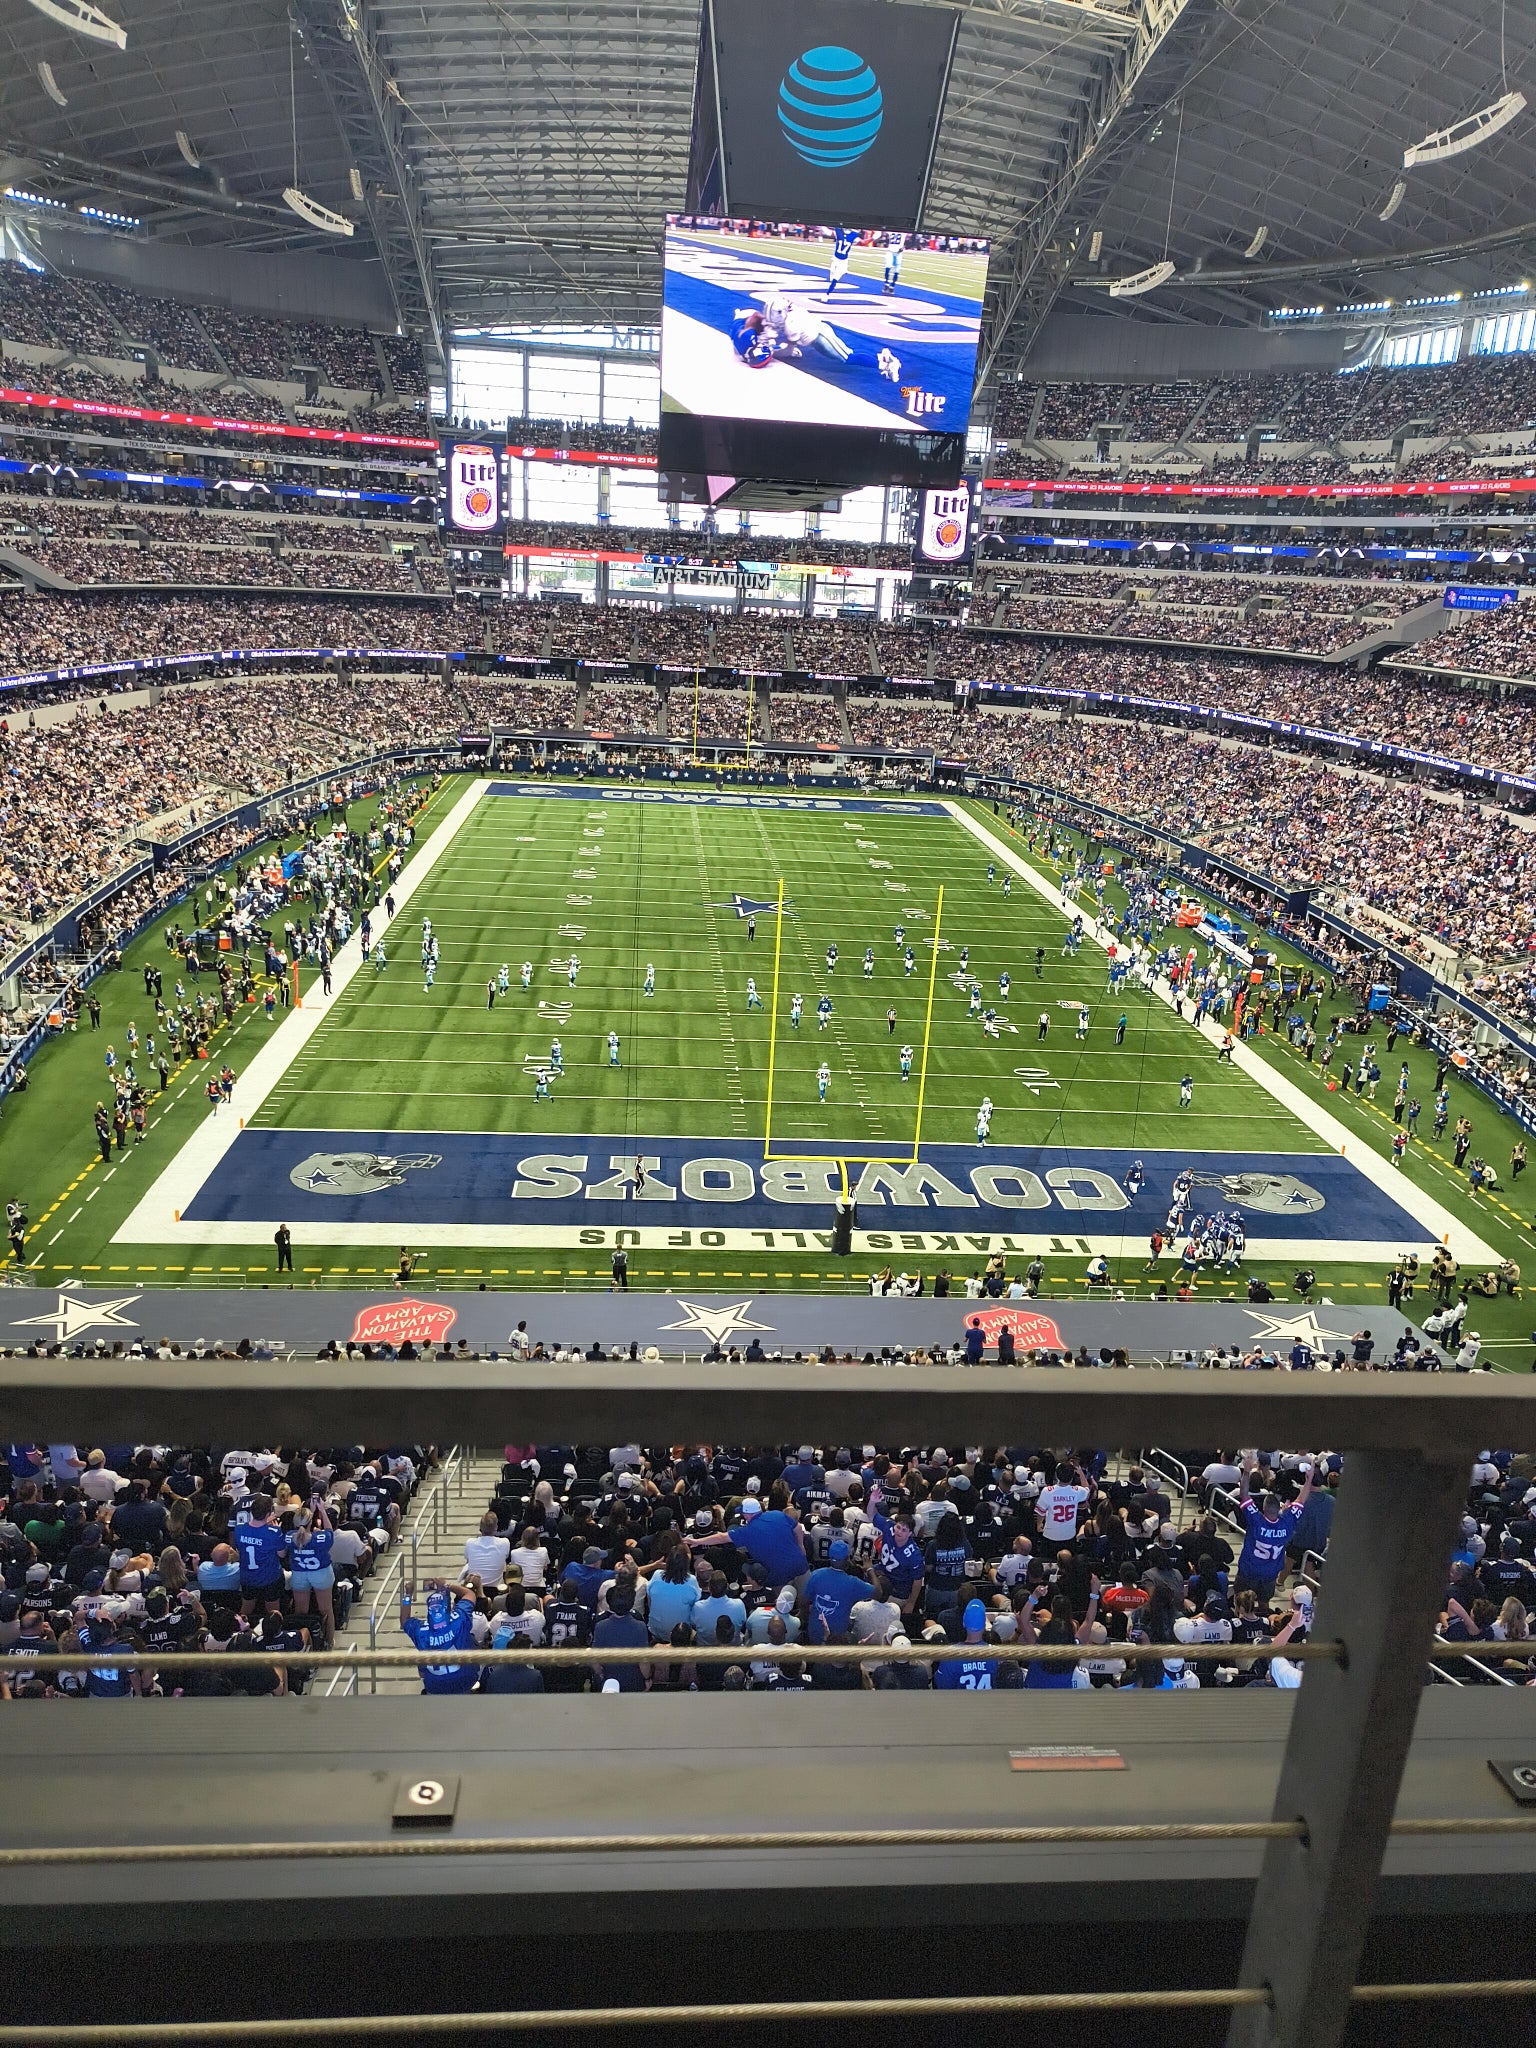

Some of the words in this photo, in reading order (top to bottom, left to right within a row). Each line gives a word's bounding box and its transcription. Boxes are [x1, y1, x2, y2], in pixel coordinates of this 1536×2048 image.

[836, 239, 852, 254] 17
[906, 391, 946, 417] Lite
[461, 463, 495, 485] Lite
[933, 495, 967, 517] Lite
[654, 568, 694, 584] AT&T
[698, 571, 769, 590] STADIUM
[506, 656, 550, 664] Blockchain.com
[601, 790, 842, 808] COWBOYS
[537, 1000, 573, 1019] 20
[522, 1054, 563, 1075] 10
[1014, 1067, 1062, 1089] 10
[511, 1154, 1128, 1211] COWBOYS
[579, 1230, 641, 1245] US
[668, 1230, 726, 1246] OF
[752, 1232, 851, 1248] ALL
[866, 1234, 1024, 1252] TAKES
[1050, 1238, 1092, 1253] IT
[369, 1305, 424, 1325] ARMY
[980, 1313, 1018, 1330] ARMY
[361, 1311, 451, 1338] SALVATION
[394, 1326, 432, 1340] THE
[1016, 1333, 1048, 1347] THE
[228, 1456, 248, 1465] BRYANT
[806, 1490, 830, 1498] AIKMAN
[351, 1503, 380, 1518] 87
[1053, 1504, 1075, 1522] 26
[1260, 1527, 1287, 1537] TAYLOR
[240, 1535, 263, 1546] NABERS
[246, 1546, 259, 1569] 1
[904, 1545, 916, 1557] 97
[23, 1598, 52, 1608] PARSONS
[1116, 1595, 1145, 1603] McELROY
[556, 1612, 577, 1620] FRANK
[150, 1632, 168, 1641] LAMB
[1246, 1630, 1263, 1639] LAMB
[1089, 1662, 1105, 1670] LAMB
